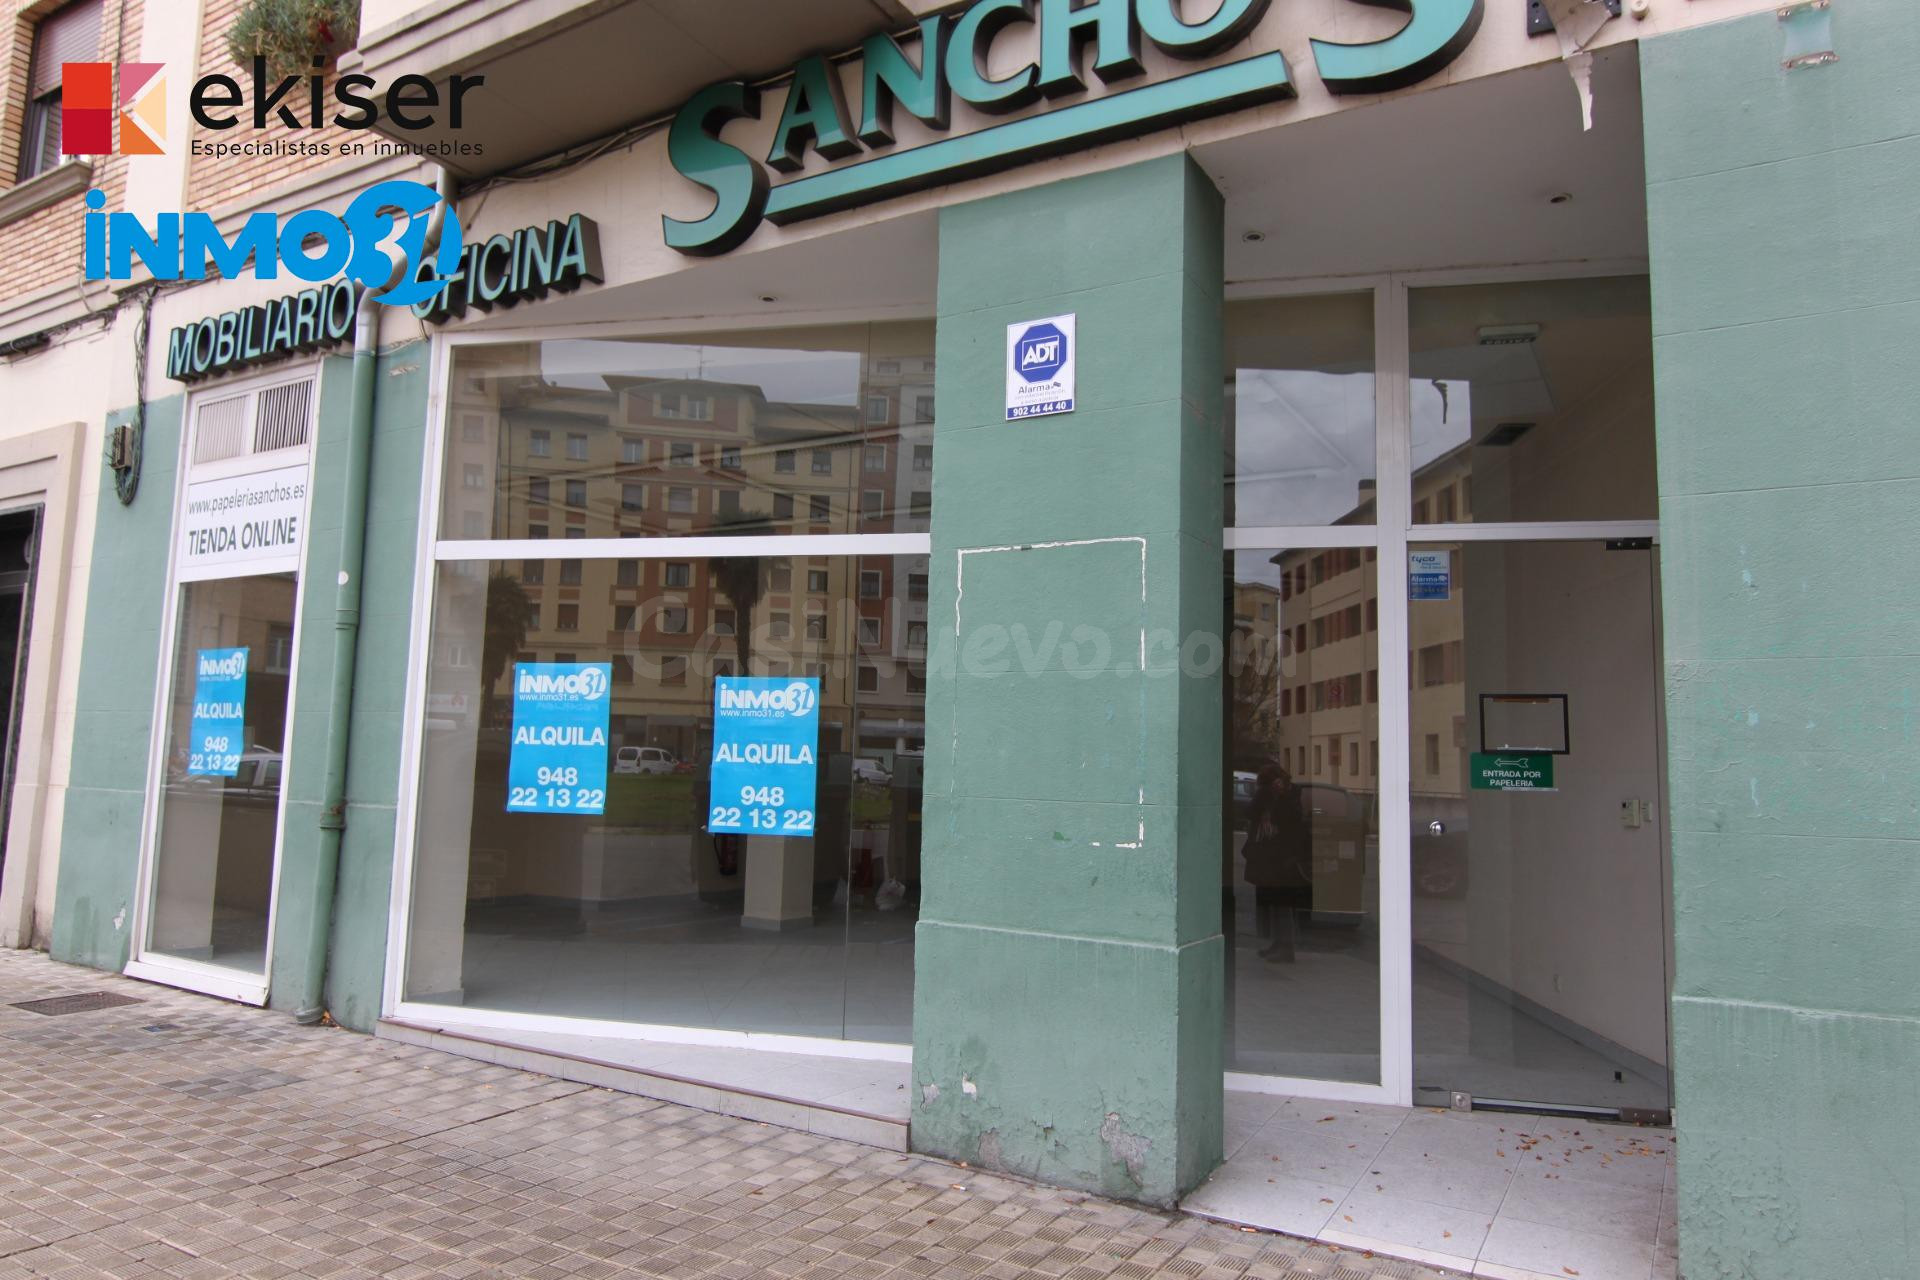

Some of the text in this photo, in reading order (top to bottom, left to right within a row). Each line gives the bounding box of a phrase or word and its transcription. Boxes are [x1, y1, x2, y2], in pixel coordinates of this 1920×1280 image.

[409, 212, 588, 321] OFICINA
[167, 277, 357, 379] MOBILIARIO
[1023, 340, 1059, 366] ADT
[1019, 384, 1051, 393] Alarma
[1013, 401, 1066, 417] 902 44 44 40
[189, 482, 305, 517] www.papeleriasanchos.es
[189, 516, 297, 555] TIENDA ONLINE
[194, 703, 243, 719] ALQUILA
[720, 709, 785, 718] www.inmo31.es
[204, 736, 228, 752] 948
[514, 726, 605, 746] ALQUILA
[190, 754, 240, 770] 22 13 22
[715, 743, 814, 765] ALQUILA
[537, 766, 578, 786] 948
[1482, 769, 1521, 778] ENTRADA
[1489, 779, 1534, 787] PAPELERIA
[510, 787, 604, 809] 22 13 22
[740, 785, 785, 807] 948
[711, 806, 813, 830] 22 13 22
